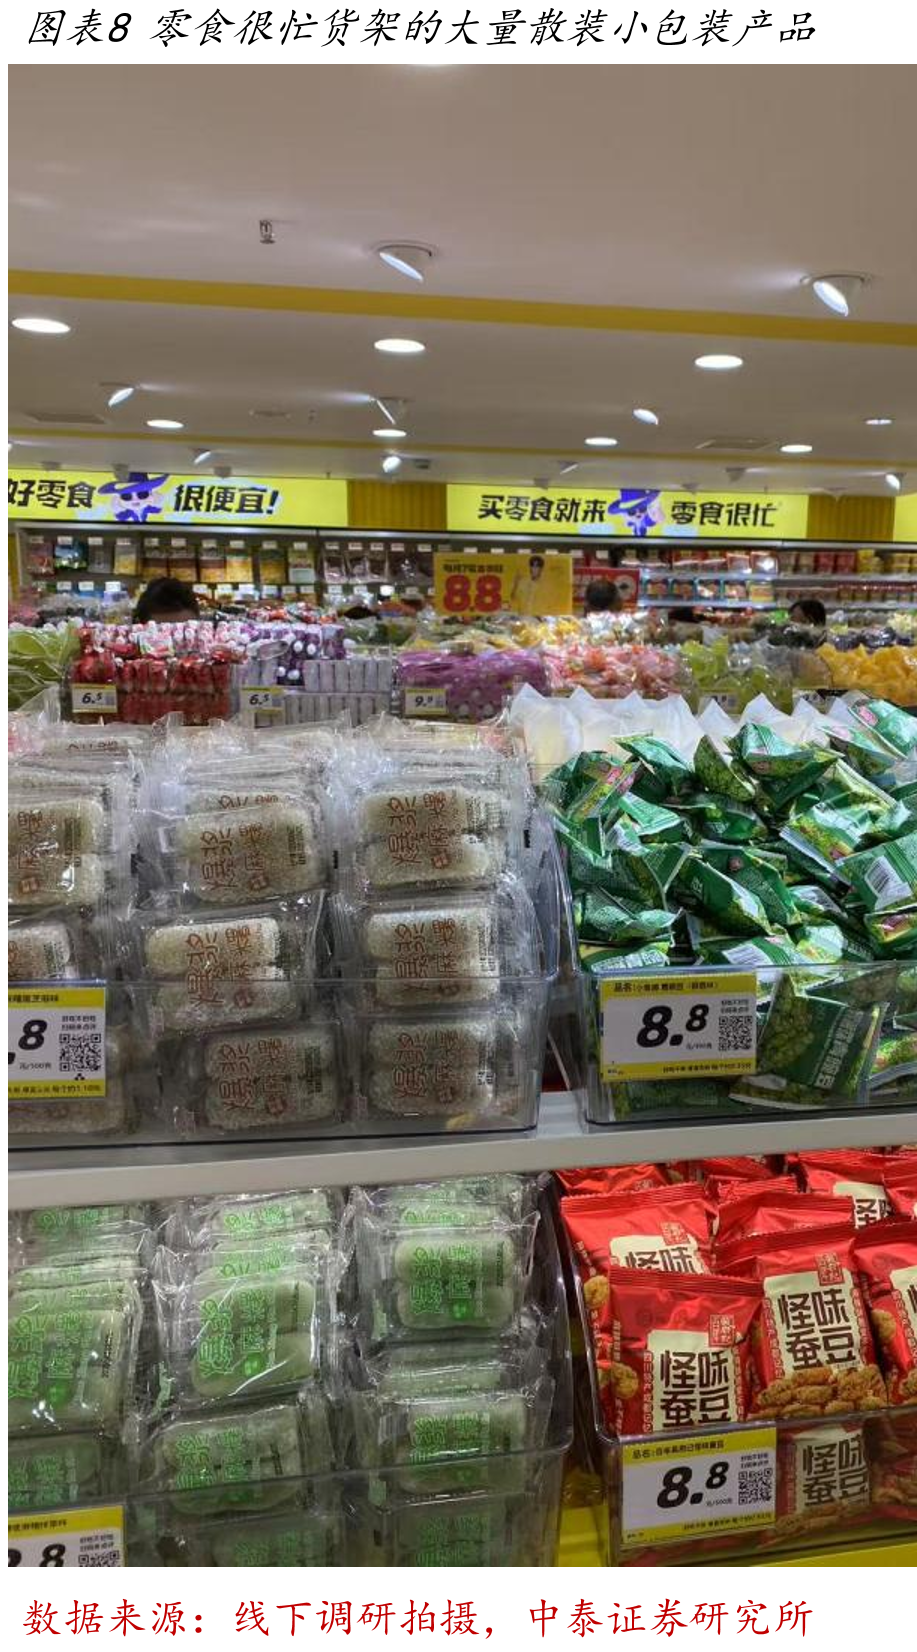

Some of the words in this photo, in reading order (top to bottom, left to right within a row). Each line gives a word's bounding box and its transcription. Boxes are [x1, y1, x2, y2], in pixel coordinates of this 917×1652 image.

[477, 494, 607, 523] 买零食就来
[670, 500, 778, 528] 零食很忙
[636, 1003, 710, 1048] 8.8
[778, 1288, 850, 1331] 怪味
[785, 1326, 858, 1371] 蚕豆
[660, 1350, 730, 1389] 怪味
[660, 1386, 732, 1428] 蚕豆
[803, 1435, 861, 1476] 怪味
[657, 1461, 730, 1509] 8.8
[803, 1468, 868, 1506] 蚕豆
